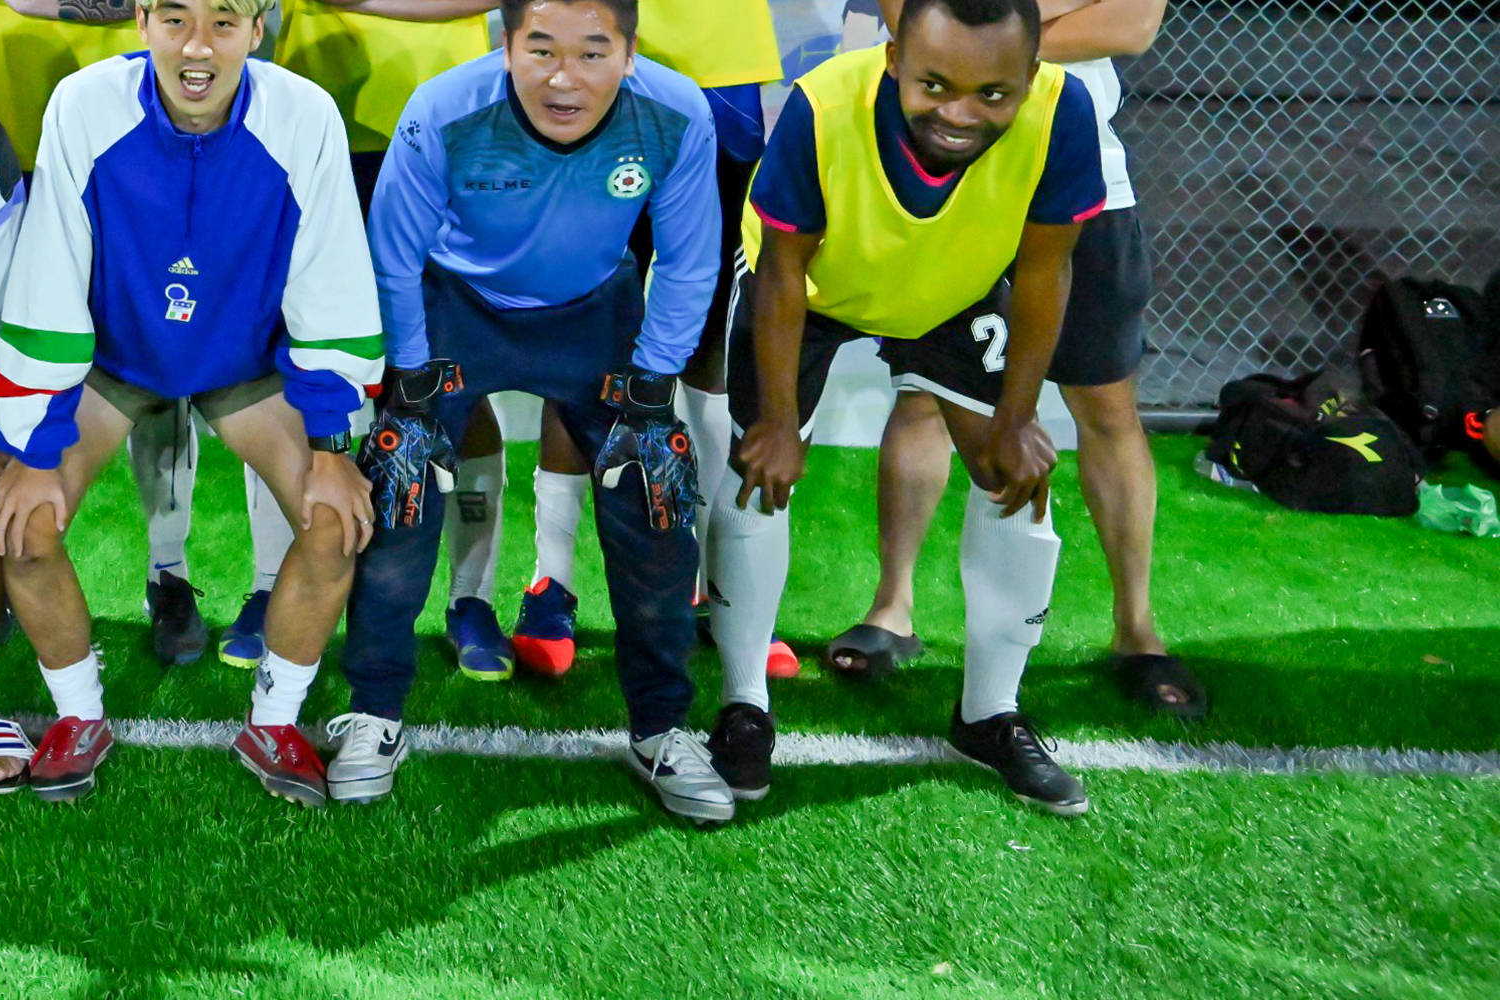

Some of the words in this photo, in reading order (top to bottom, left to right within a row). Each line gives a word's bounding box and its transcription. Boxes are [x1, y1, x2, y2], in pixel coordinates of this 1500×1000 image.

[464, 178, 533, 192] KELME
[168, 266, 199, 276] adidas
[970, 312, 1008, 373] 2
